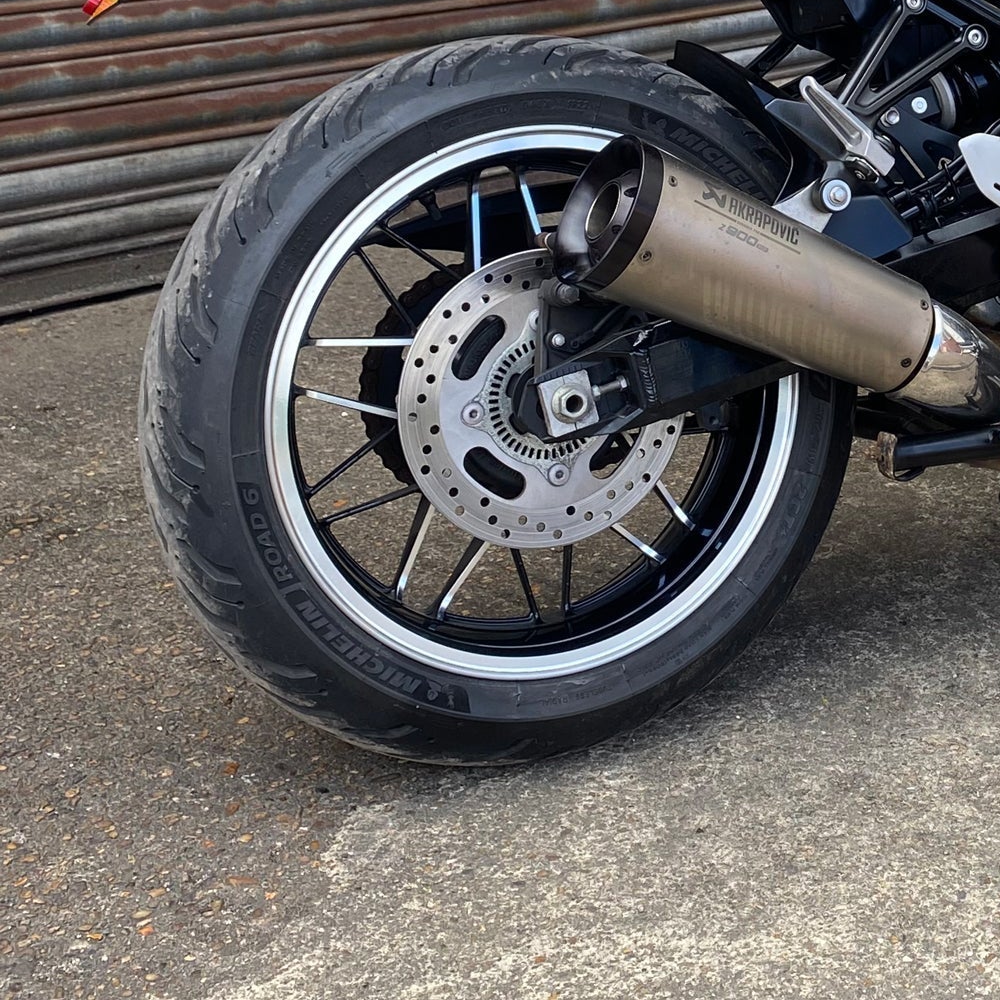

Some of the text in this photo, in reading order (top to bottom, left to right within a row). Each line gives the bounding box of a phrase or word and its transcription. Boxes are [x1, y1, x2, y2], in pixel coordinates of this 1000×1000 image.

[669, 127, 769, 202] MICHELI
[243, 488, 423, 694] MICHELIN ROAD 6
